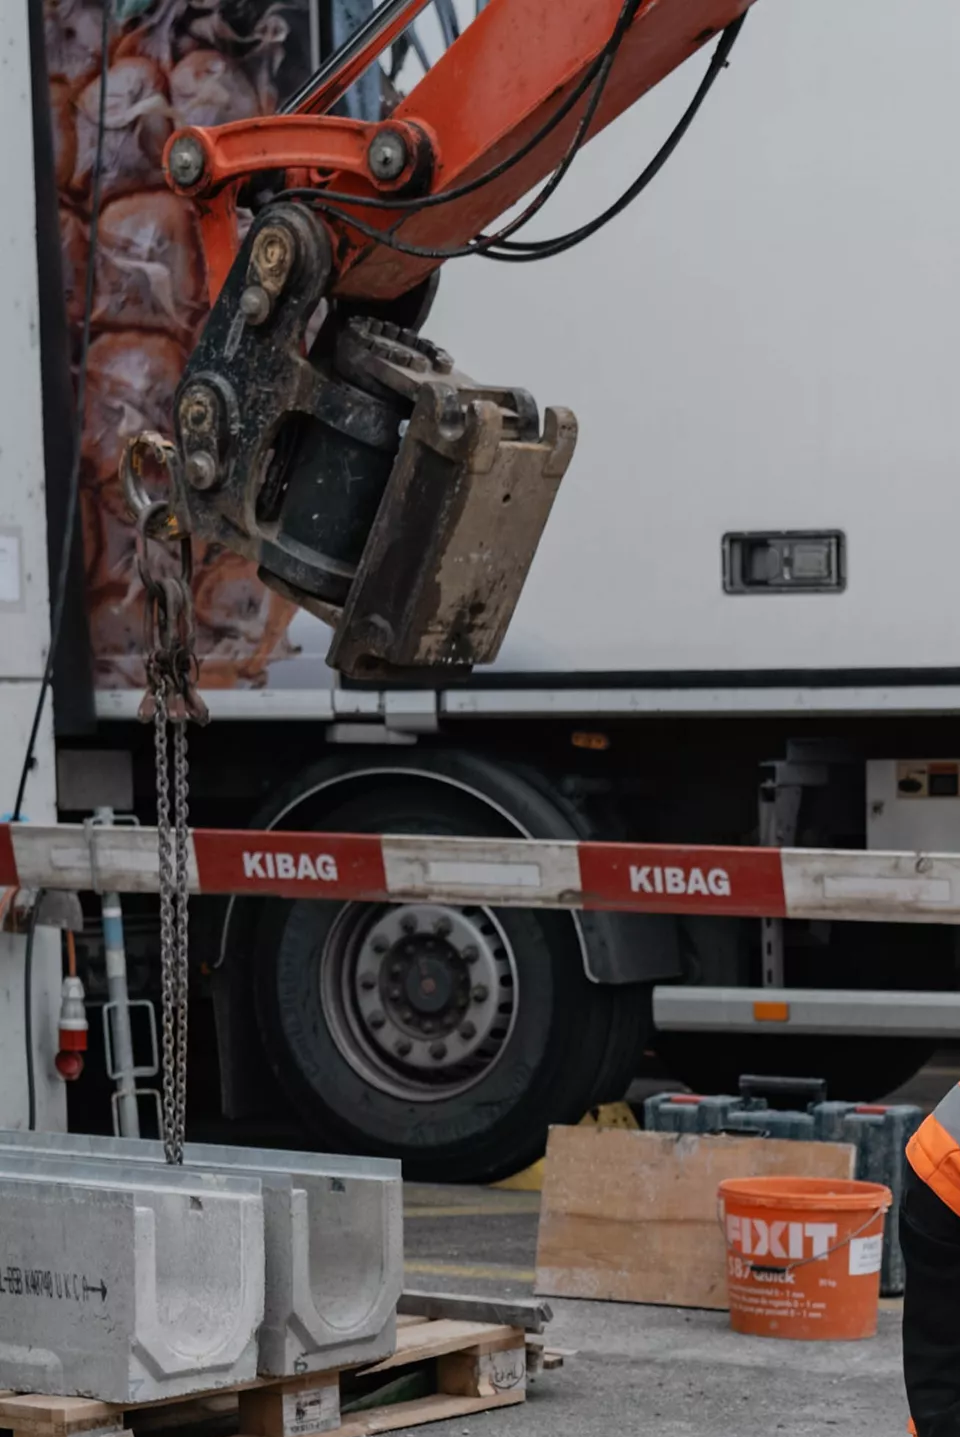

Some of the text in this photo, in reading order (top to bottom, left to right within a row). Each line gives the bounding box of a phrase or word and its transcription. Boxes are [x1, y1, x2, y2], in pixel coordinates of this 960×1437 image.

[242, 852, 338, 882] KIBAG
[629, 865, 731, 896] KIBAG
[726, 1214, 838, 1261] FIXIT
